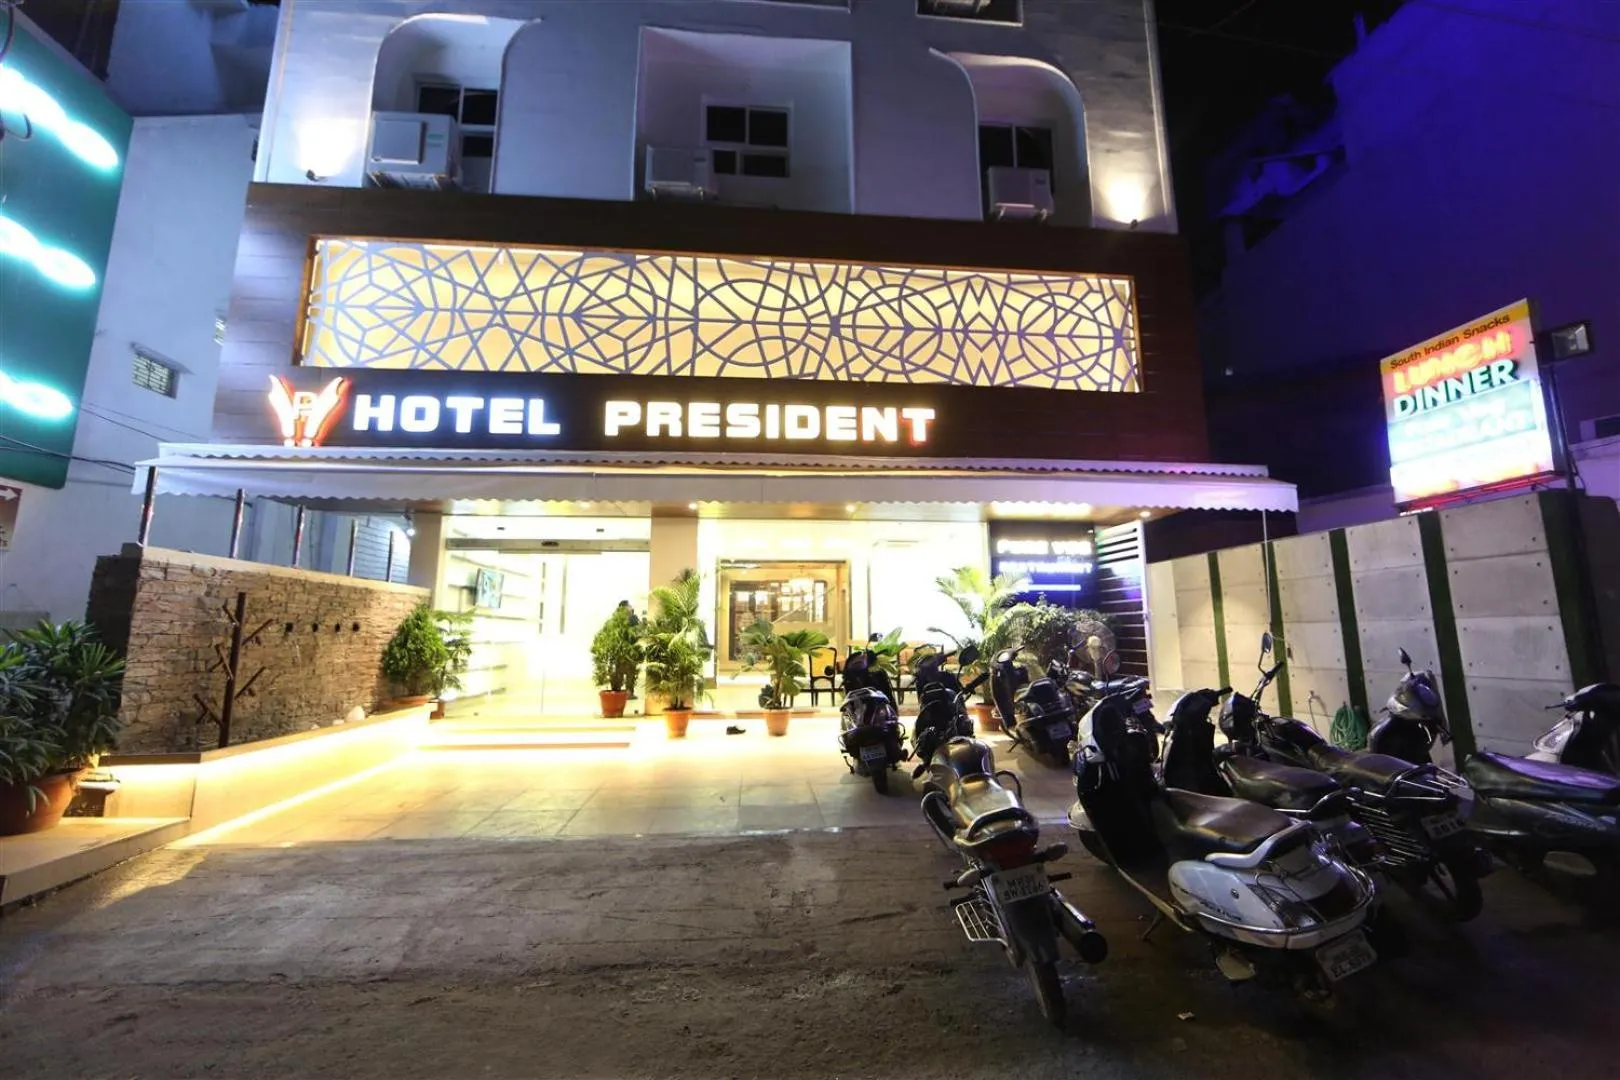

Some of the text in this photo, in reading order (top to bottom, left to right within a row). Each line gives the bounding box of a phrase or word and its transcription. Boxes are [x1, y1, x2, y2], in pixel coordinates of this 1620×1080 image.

[1390, 314, 1510, 369] South Indian Snacks
[1393, 331, 1512, 393] LUNCH
[1394, 359, 1518, 418] DINNER
[353, 394, 936, 442] HOTEL PRESIDENT
